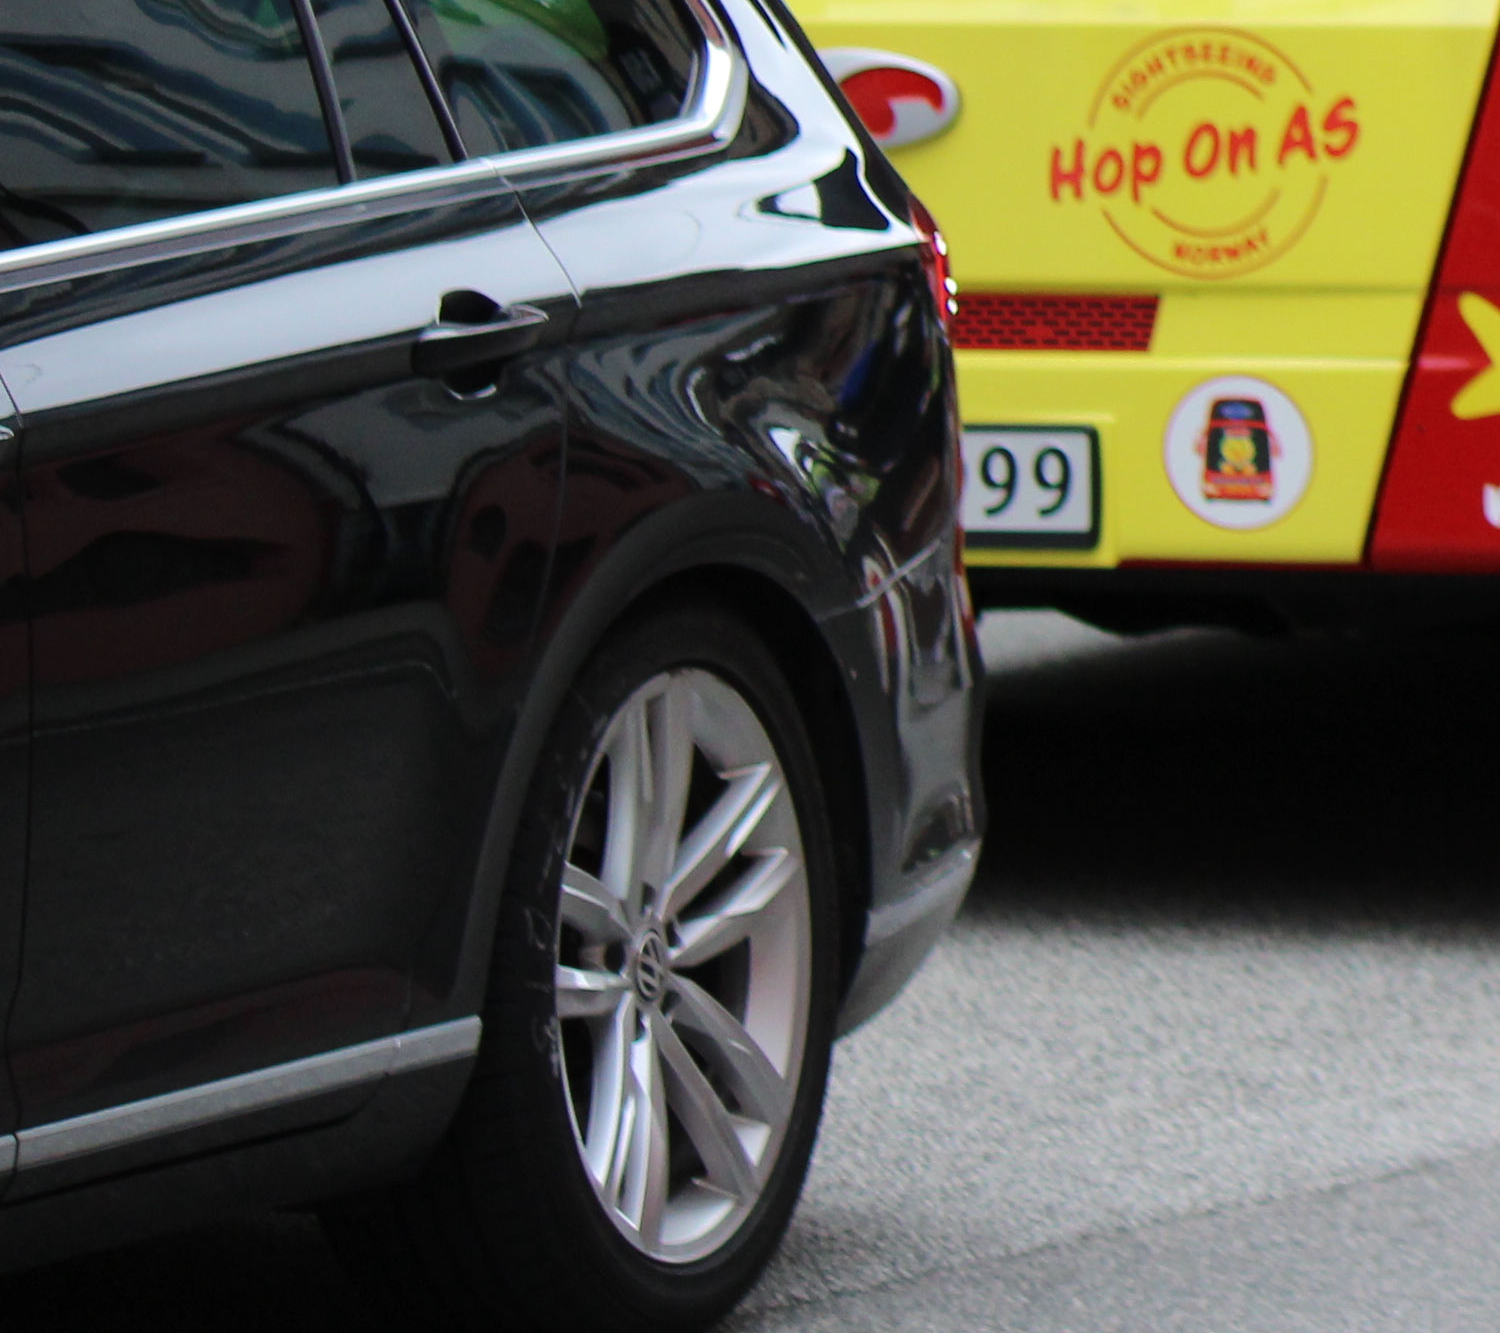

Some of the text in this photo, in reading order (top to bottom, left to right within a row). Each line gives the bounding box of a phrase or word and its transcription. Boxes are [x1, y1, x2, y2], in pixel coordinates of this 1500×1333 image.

[1049, 96, 1360, 205] Hop On AS
